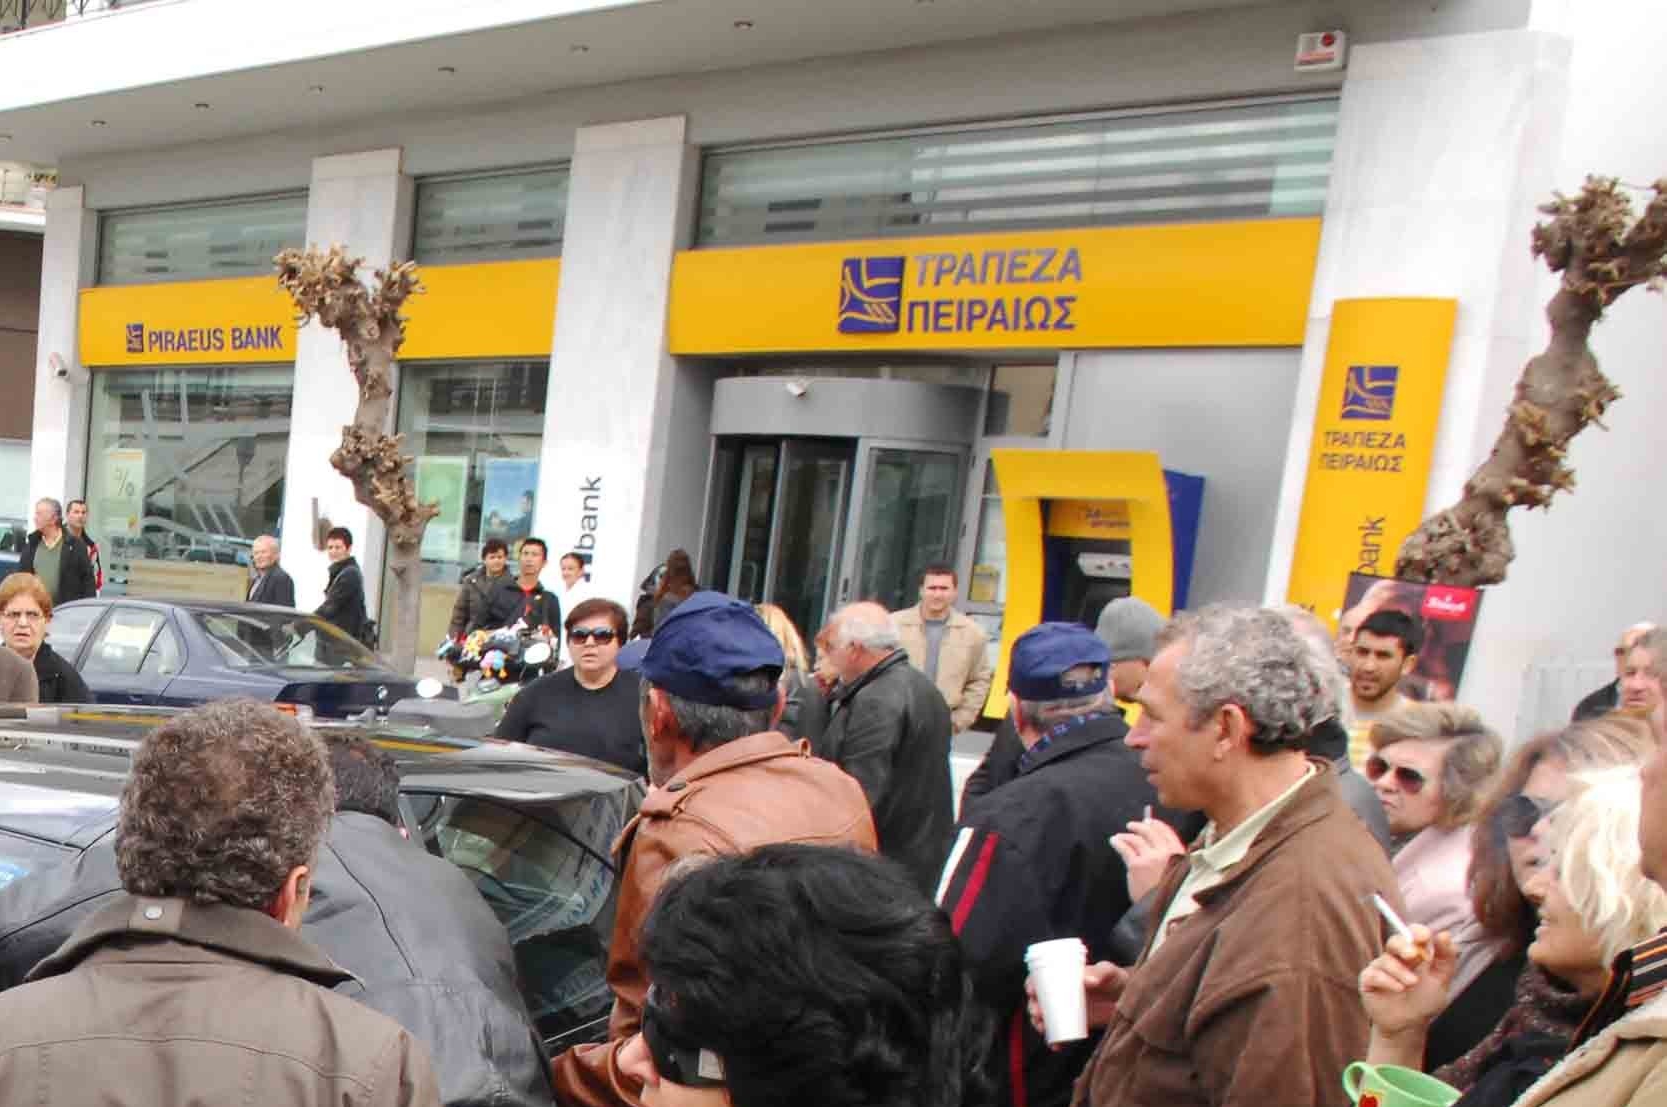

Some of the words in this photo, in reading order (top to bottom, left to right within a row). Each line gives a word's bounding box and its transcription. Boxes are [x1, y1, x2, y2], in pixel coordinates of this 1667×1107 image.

[913, 247, 1083, 287] ΤΡΑΠΕΖΑ
[907, 295, 1077, 333] ΠΕΙΡΑΙΩΣ
[148, 327, 224, 352] PIRAEUS
[230, 324, 283, 350] BANK
[1324, 431, 1406, 449] ΤΡΑΠΕΖΑ
[1319, 453, 1404, 473] ΠΕΙΡΑΙΩΣ
[574, 476, 602, 582] bank
